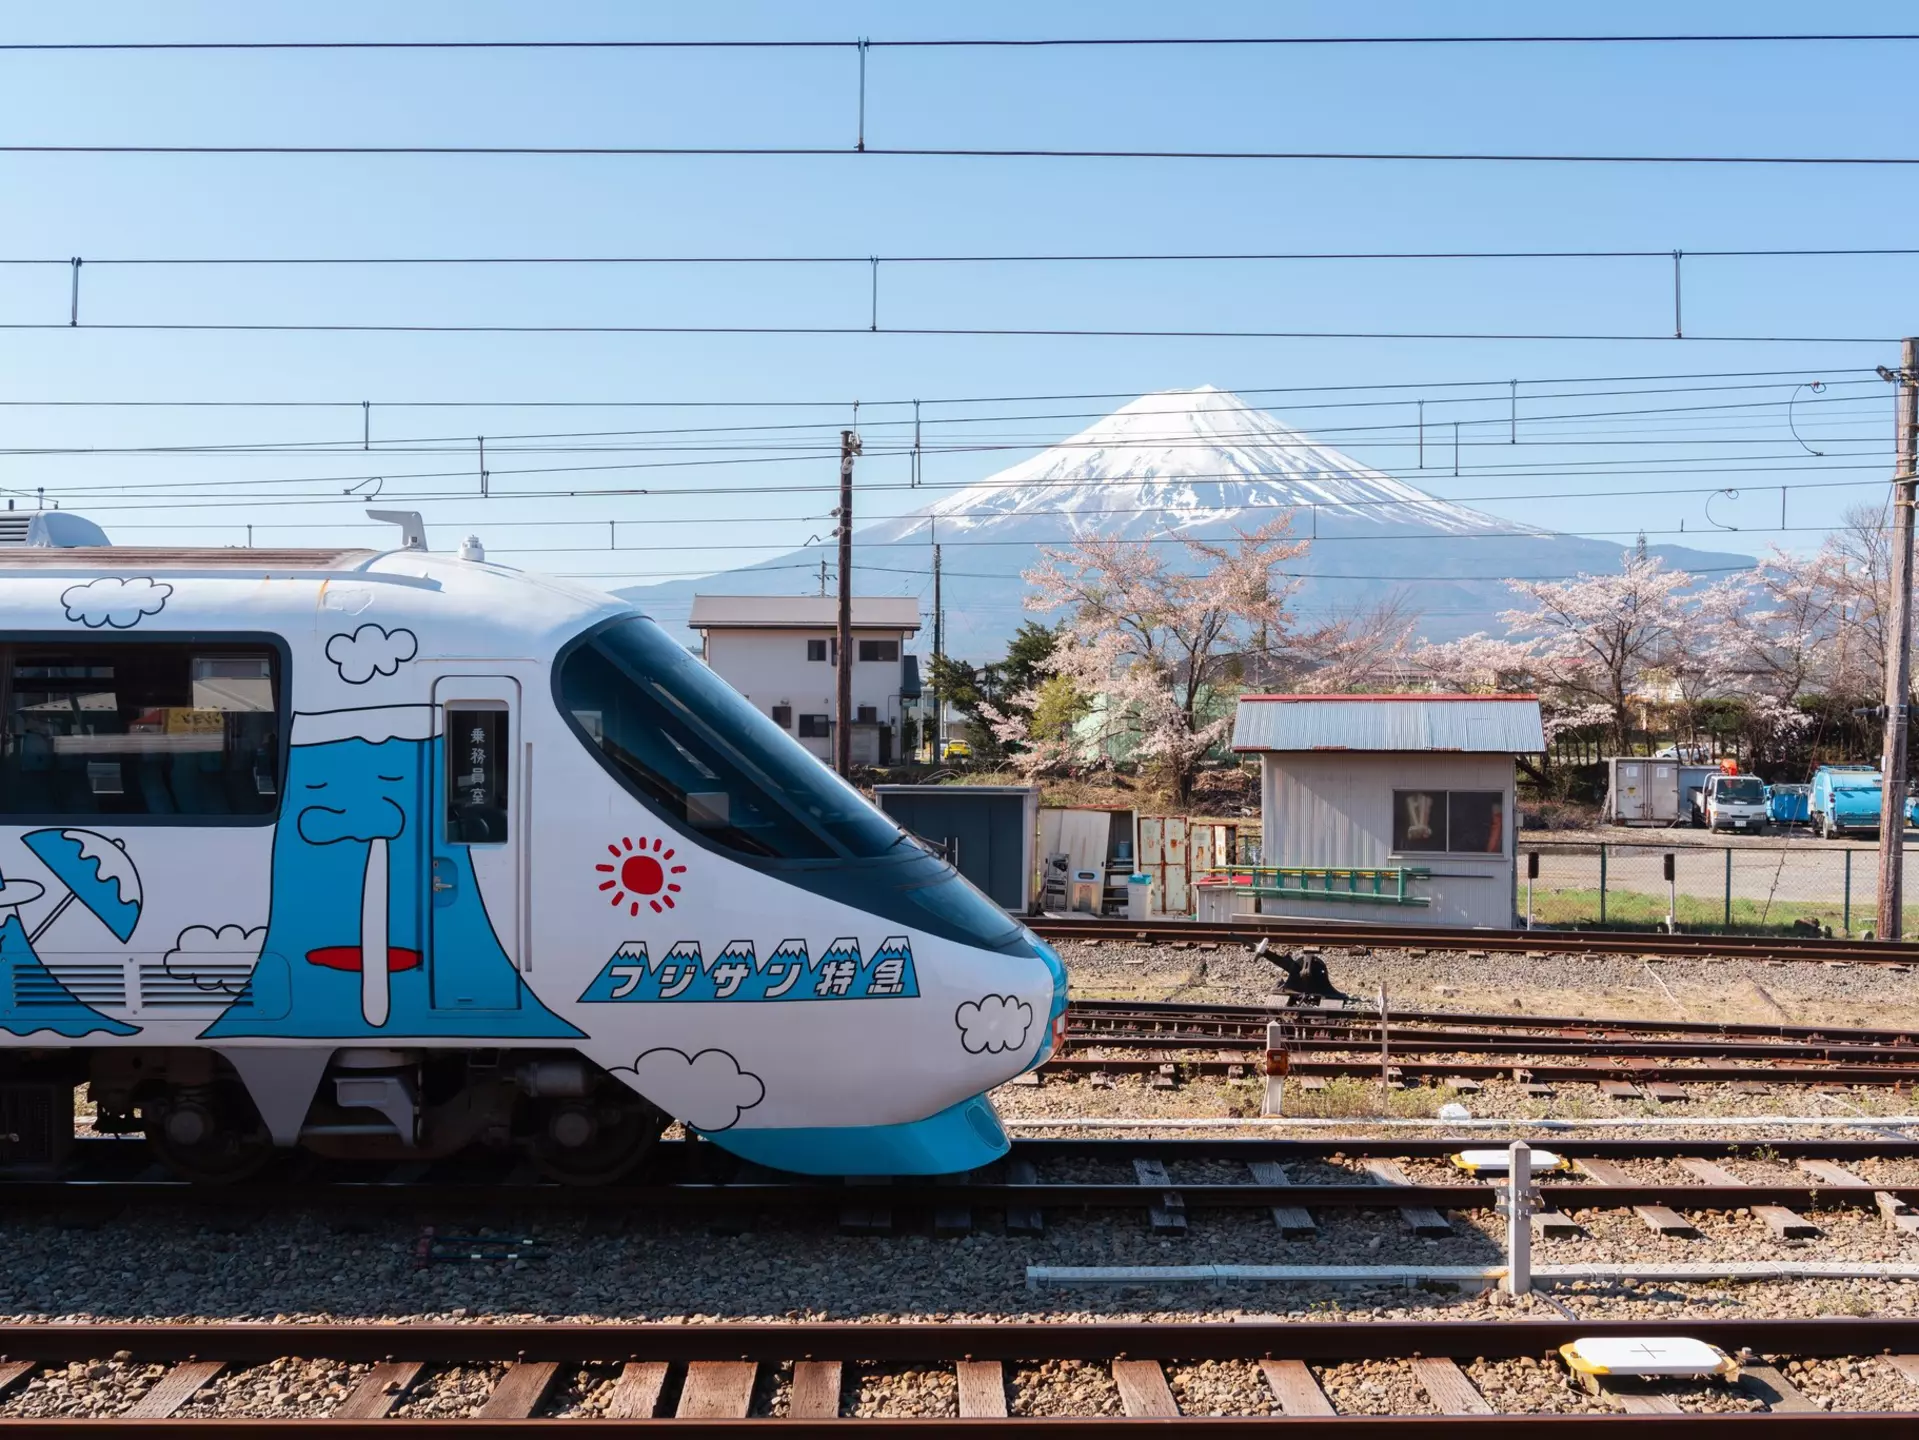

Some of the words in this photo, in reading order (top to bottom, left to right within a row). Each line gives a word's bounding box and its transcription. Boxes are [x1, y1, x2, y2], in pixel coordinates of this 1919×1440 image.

[470, 728, 486, 805] 乗務員室
[608, 958, 906, 999] フジサン特急
